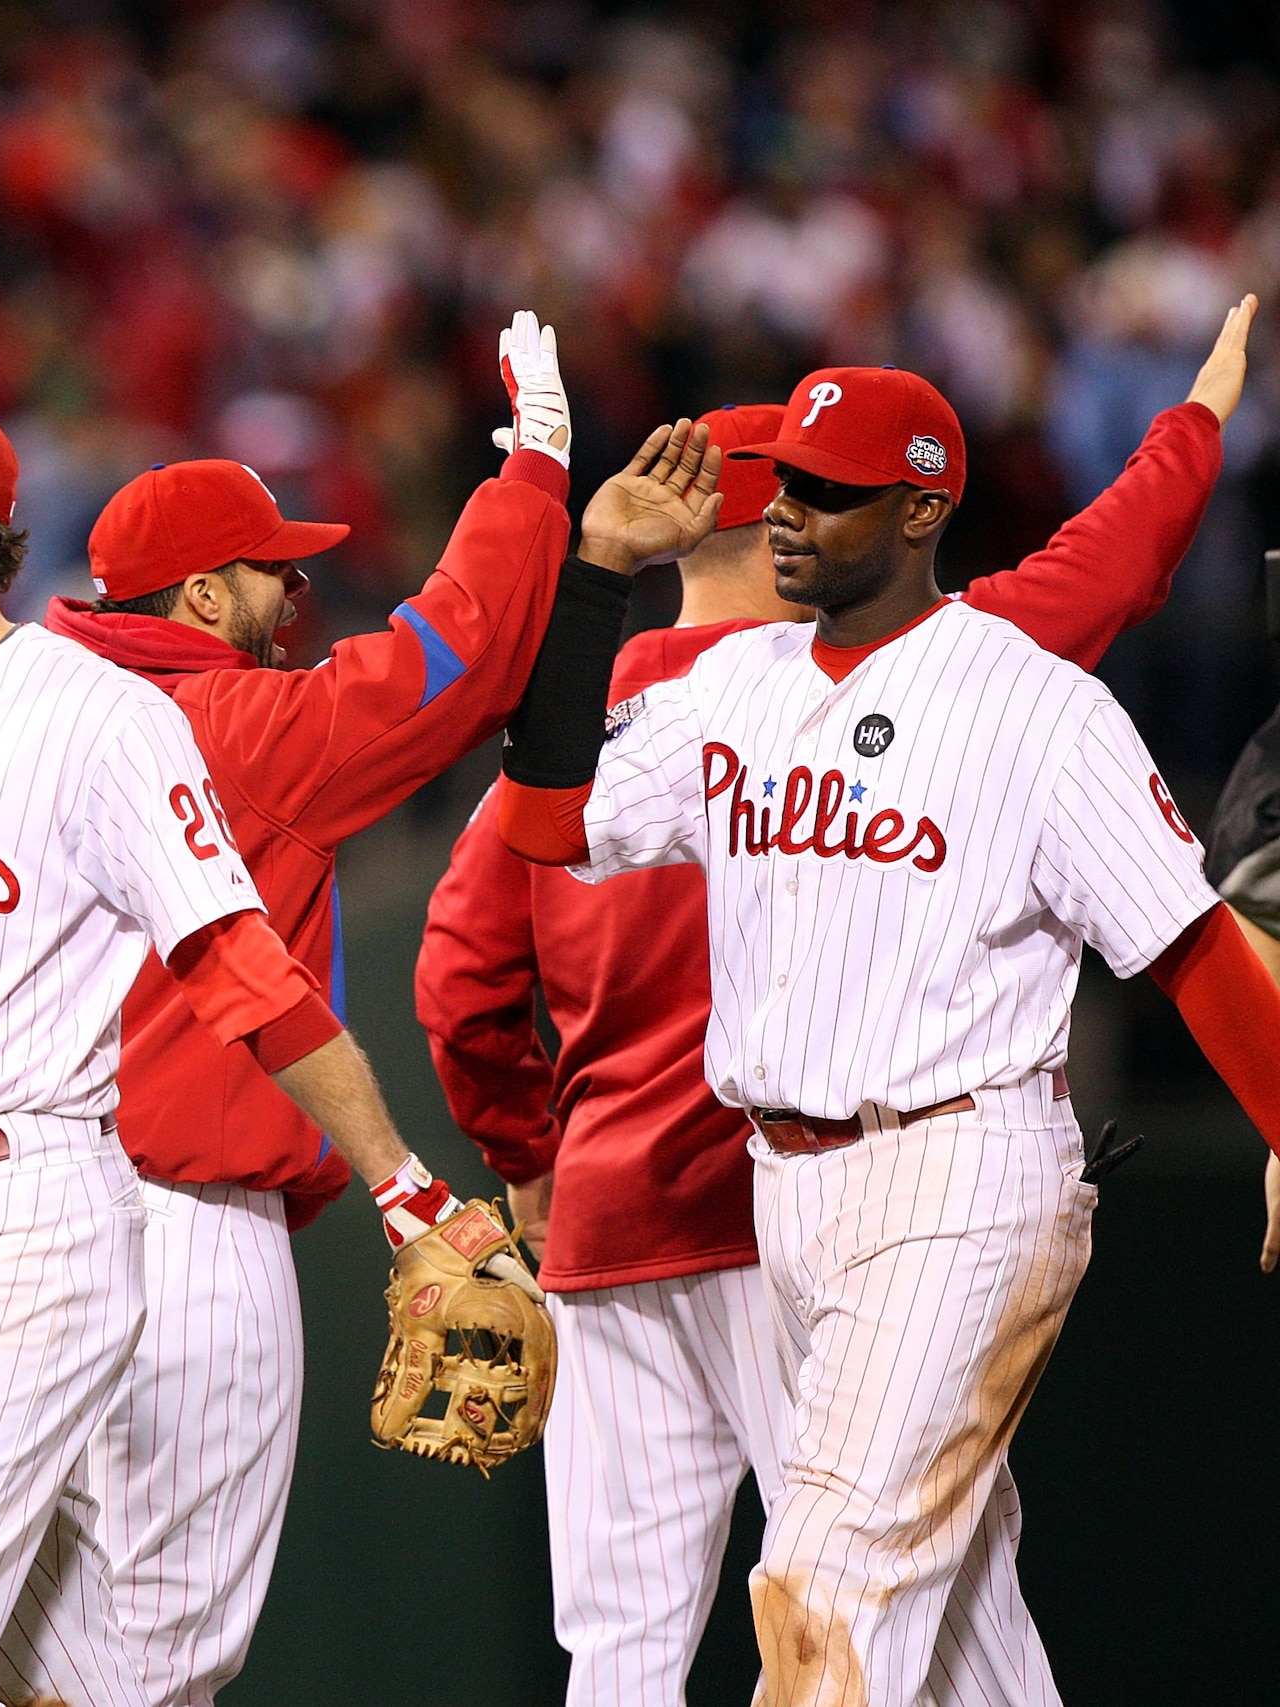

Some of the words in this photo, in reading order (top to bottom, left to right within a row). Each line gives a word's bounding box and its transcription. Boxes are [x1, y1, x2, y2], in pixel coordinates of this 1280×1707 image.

[801, 381, 843, 428] P
[909, 445, 945, 469] SERIES
[915, 438, 944, 456] WORLD
[858, 725, 889, 746] HK
[703, 741, 947, 873] Phillies
[1149, 772, 1195, 844] 6
